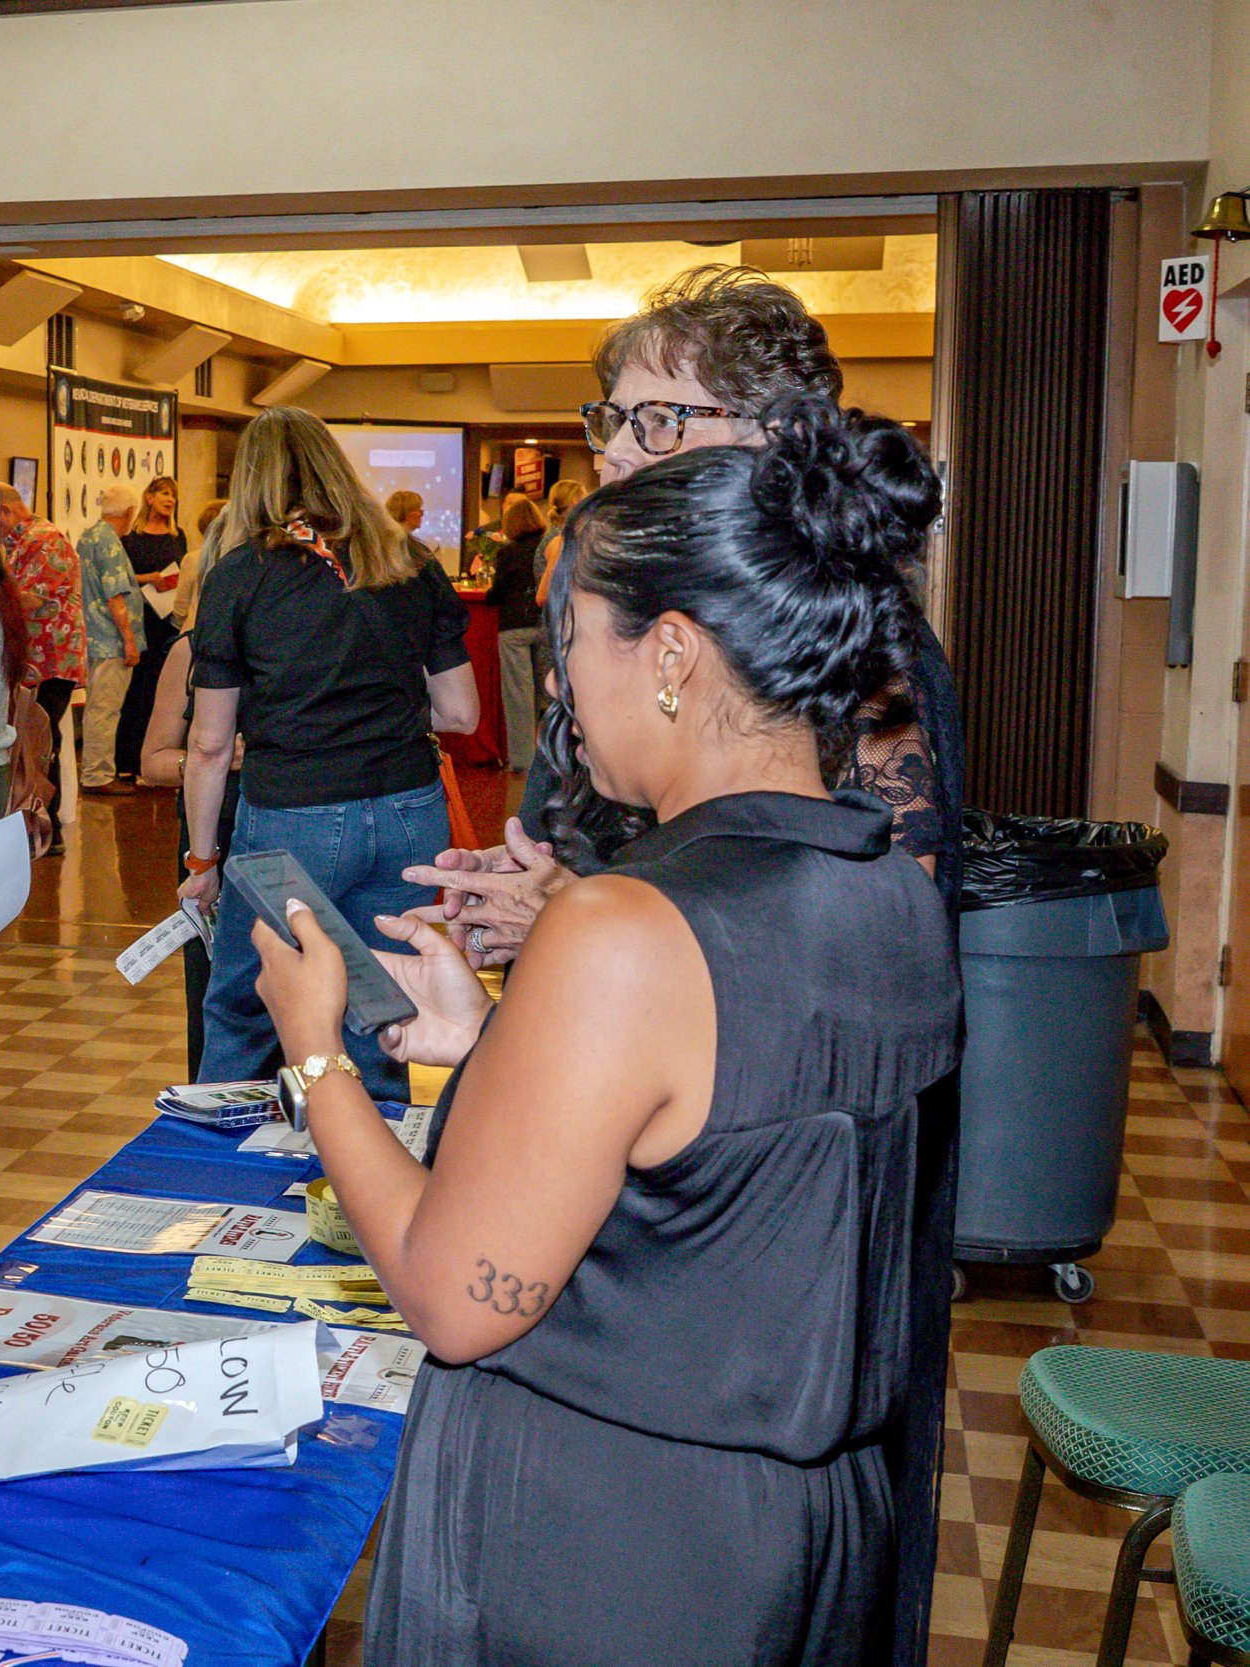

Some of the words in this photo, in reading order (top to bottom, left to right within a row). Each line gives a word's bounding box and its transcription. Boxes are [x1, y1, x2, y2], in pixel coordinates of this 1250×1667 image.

[1163, 263, 1205, 288] AED
[467, 1258, 549, 1317] 333
[247, 1297, 276, 1305] TICKET
[3, 1313, 61, 1347] 50/50
[87, 1310, 135, 1335] Veterans
[340, 1335, 378, 1360] RAFFLE
[325, 1358, 355, 1382] TICKET
[102, 1400, 122, 1430] COUPON
[117, 1408, 131, 1428] KEEP
[135, 1409, 160, 1437] TICKET
[47, 1623, 91, 1637] TICKET
[60, 1614, 89, 1622] KEEP
[131, 1630, 160, 1644] KEEP
[120, 1639, 162, 1661] TICKET
